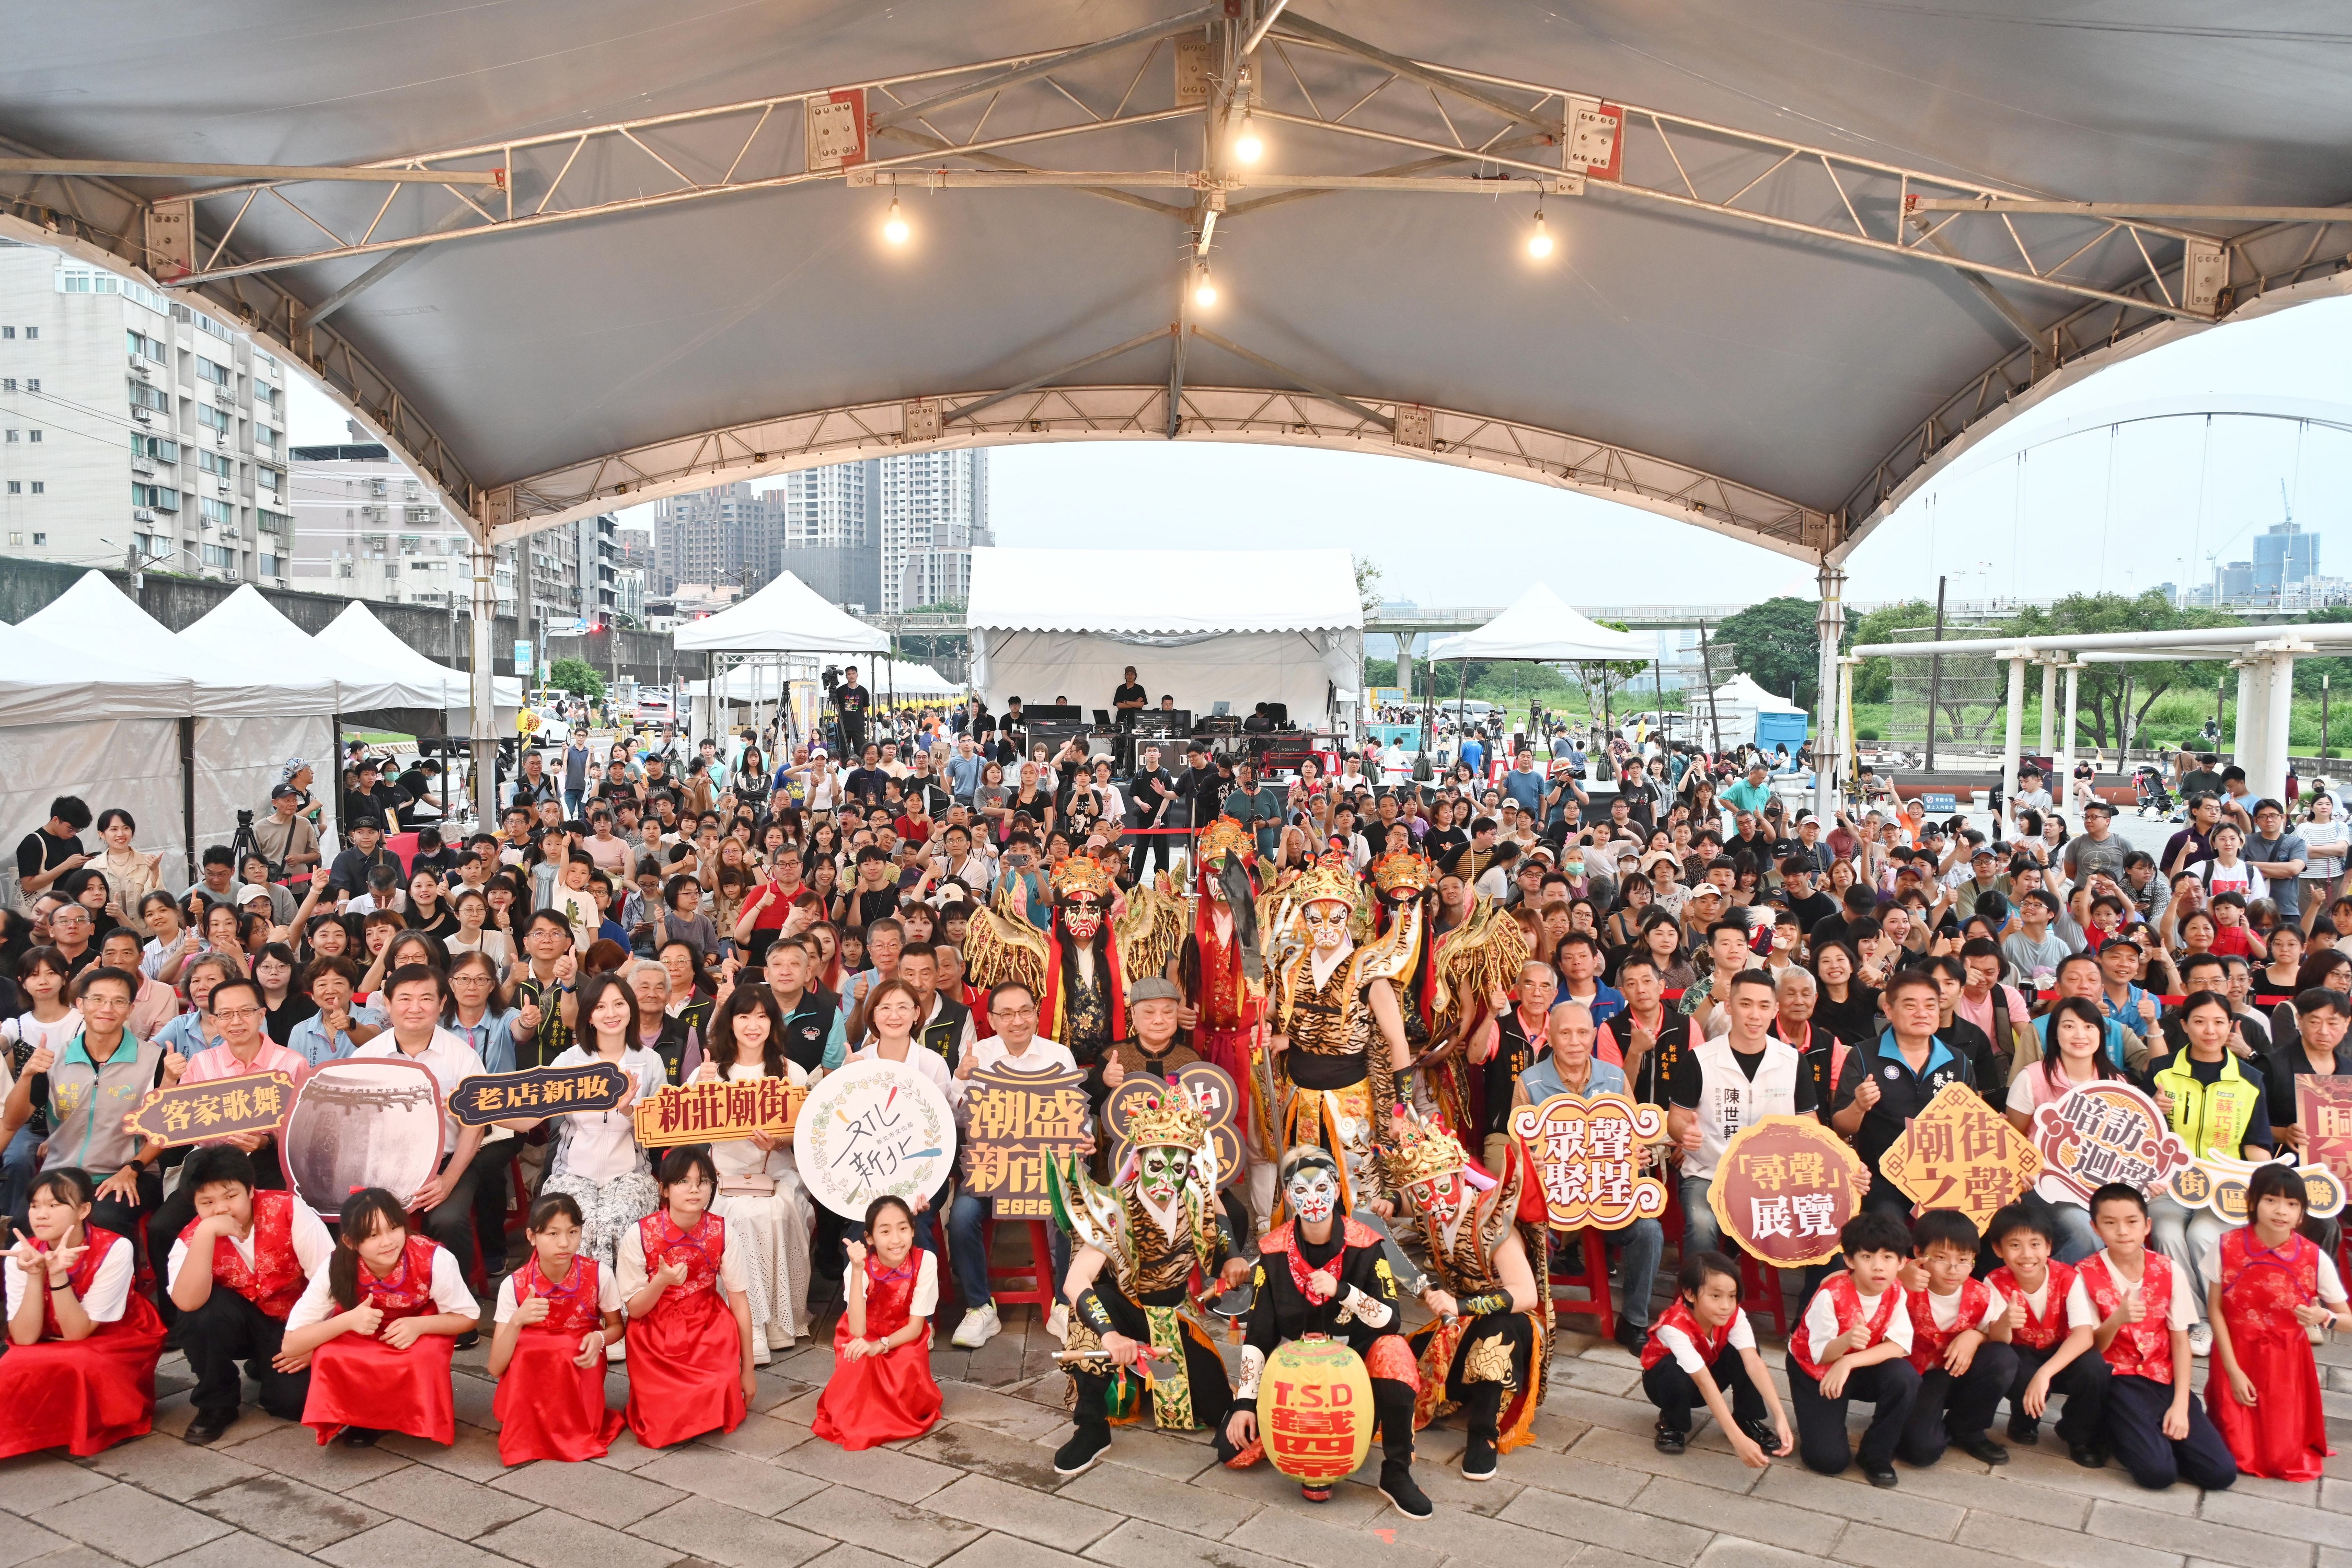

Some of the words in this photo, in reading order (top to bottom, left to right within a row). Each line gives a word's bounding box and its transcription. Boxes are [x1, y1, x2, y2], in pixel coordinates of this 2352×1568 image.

[669, 1057, 678, 1076] 新莊
[1669, 1044, 1677, 1062] 新莊
[161, 1085, 282, 1133] 客家歌舞
[470, 1077, 610, 1111] 老店新妝
[658, 1079, 791, 1134] 新莊廟街
[969, 1089, 1088, 1140] 潮盛
[1724, 1088, 1740, 1141] 陳世軒
[877, 1122, 914, 1145] 新北市文化局
[1544, 1117, 1632, 1162] 眾聲
[1906, 1112, 2010, 1164] 廟街
[2064, 1091, 2151, 1153] 暗訪
[2211, 1099, 2234, 1149] 蘇巧慧
[1544, 1163, 1631, 1206] 聚埕
[1739, 1151, 1841, 1189] 「尋聲」
[1910, 1165, 2014, 1216] 之聲
[2071, 1143, 2158, 1203] 迴聲
[997, 1198, 1052, 1215] 2026
[1750, 1194, 1838, 1240] 展覽
[1274, 1380, 1353, 1408] T.S.D
